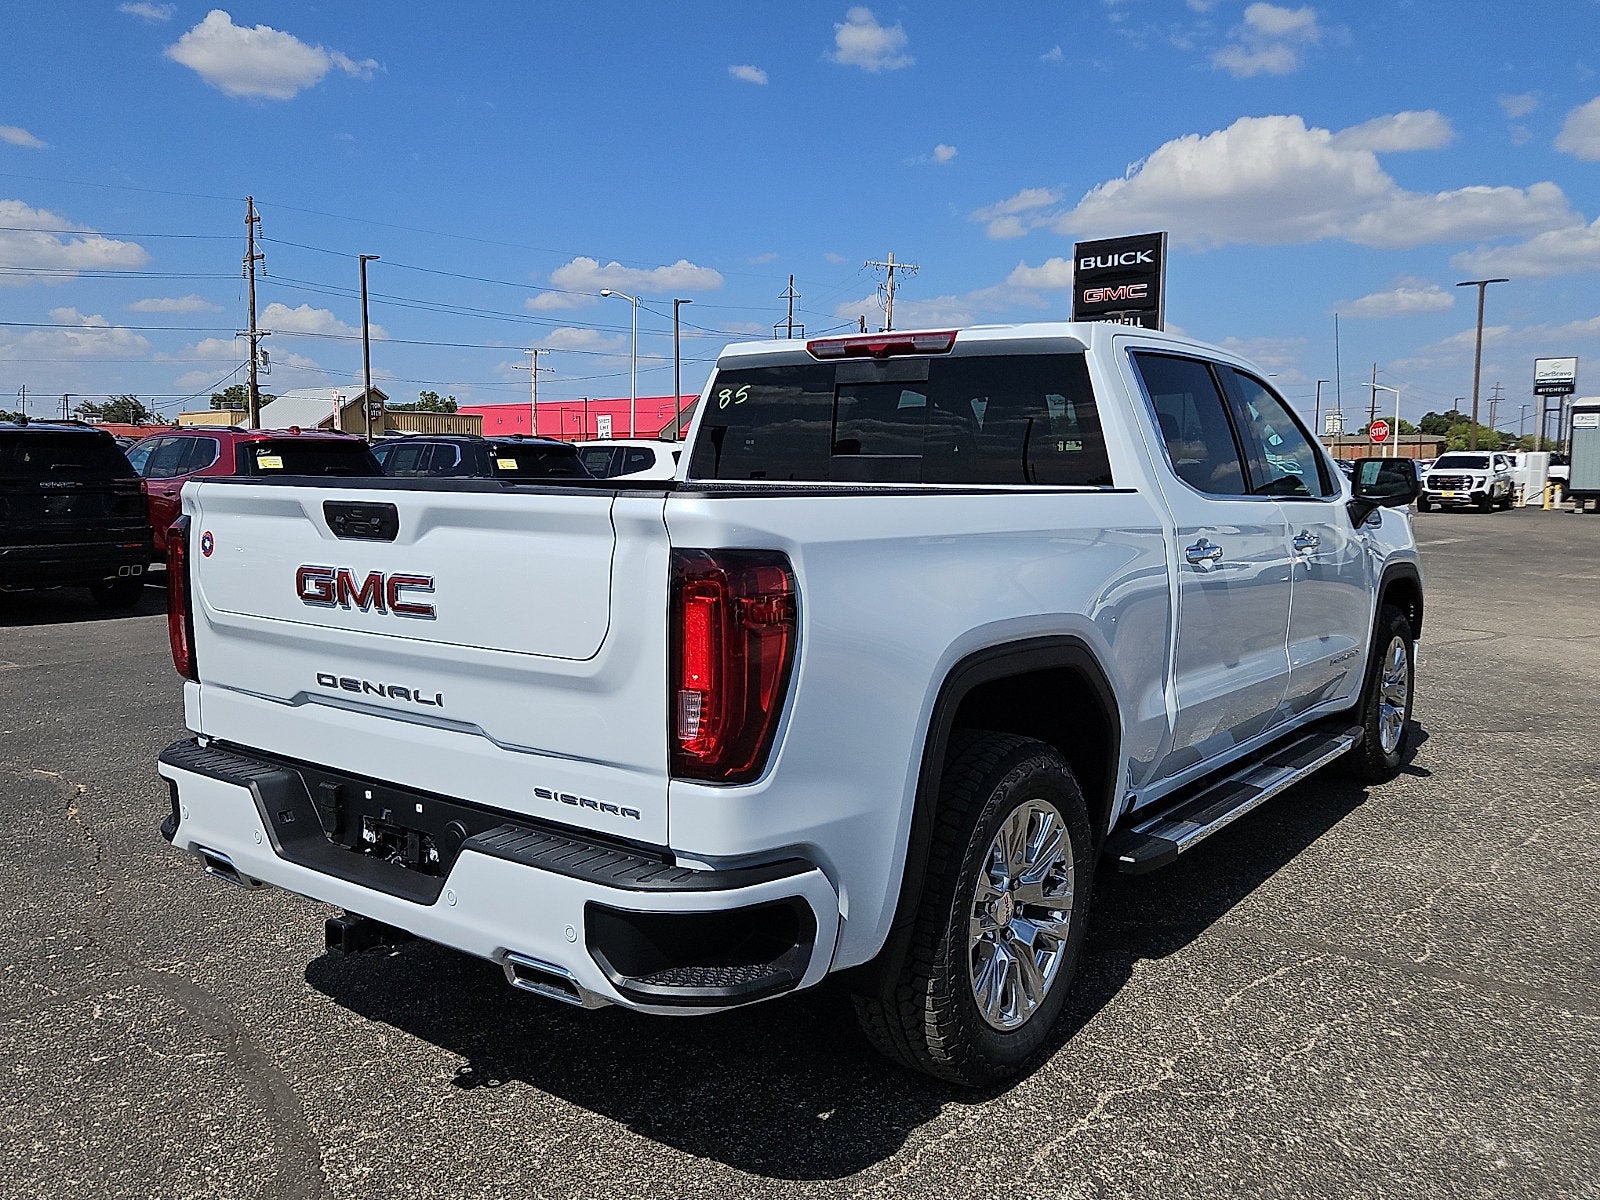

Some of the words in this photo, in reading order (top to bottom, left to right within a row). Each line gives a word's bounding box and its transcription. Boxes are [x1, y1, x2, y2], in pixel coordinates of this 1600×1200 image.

[1080, 249, 1154, 271] BUICK
[1083, 283, 1148, 303] GMC
[719, 384, 751, 410] 85
[1371, 426, 1388, 437] STOP
[296, 564, 437, 621] GMC
[316, 672, 444, 707] DENALI
[533, 787, 641, 820] SIERRA
